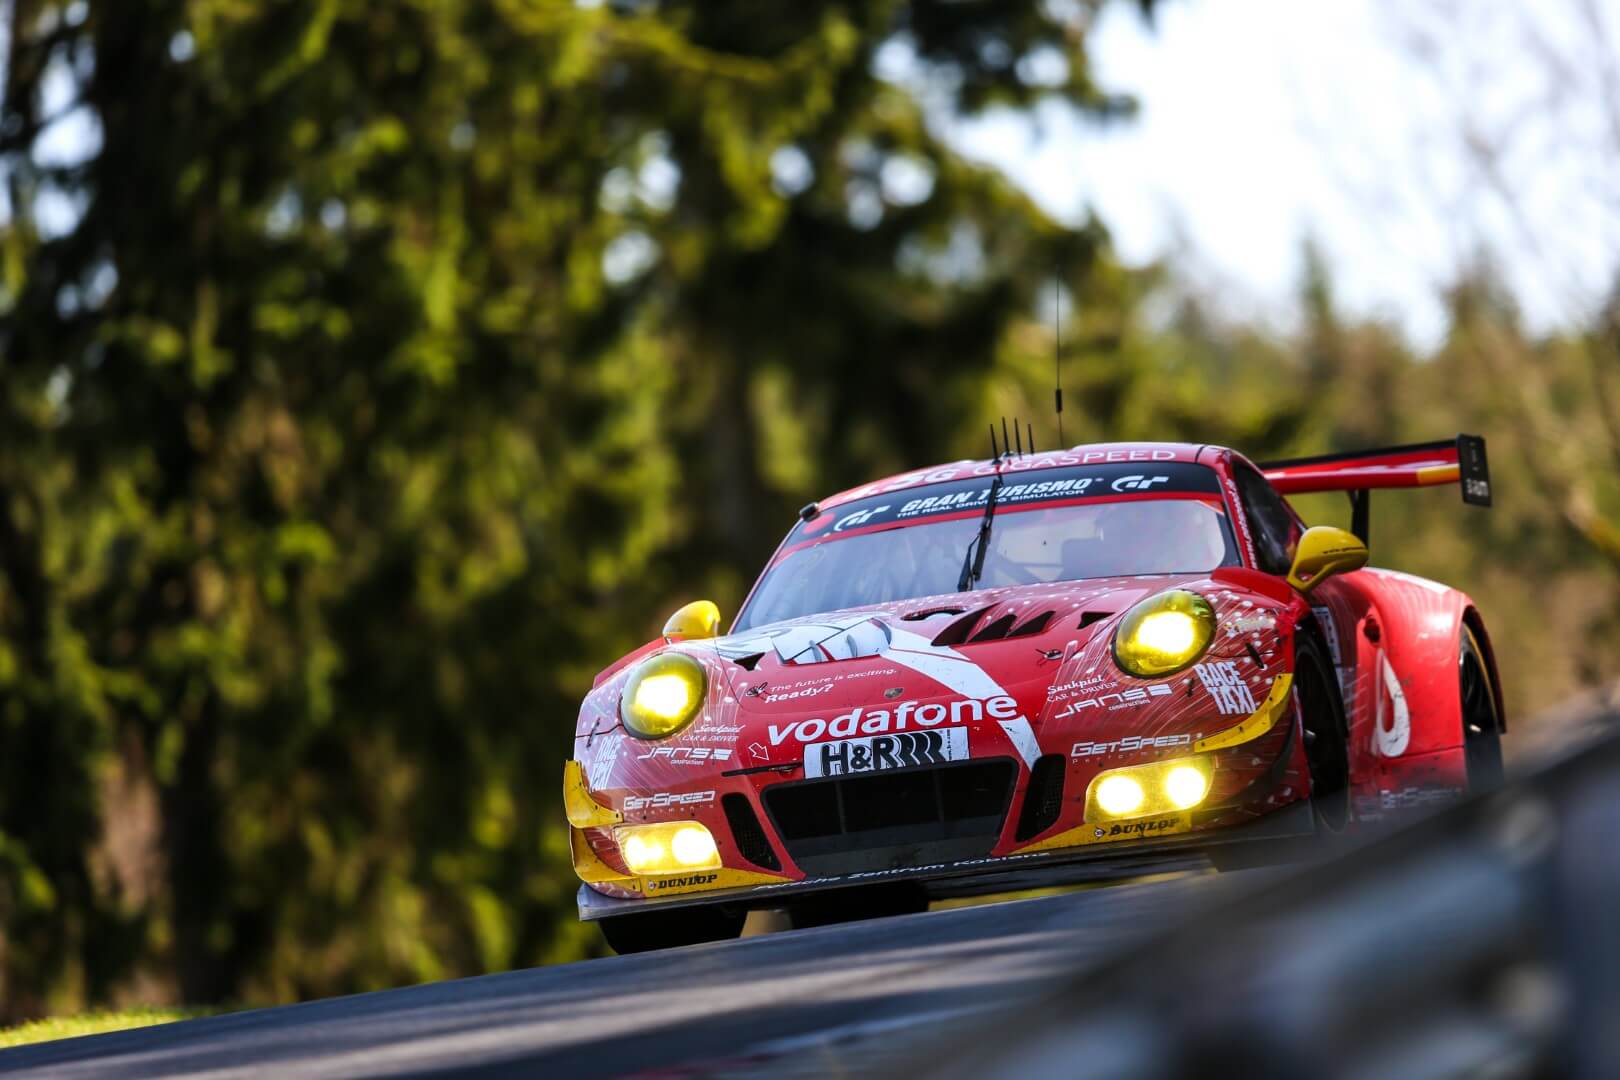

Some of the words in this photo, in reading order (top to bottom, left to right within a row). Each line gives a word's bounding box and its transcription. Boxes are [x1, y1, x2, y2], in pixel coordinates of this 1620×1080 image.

[973, 449, 1176, 475] GIGASPEED
[897, 508, 919, 518] THE
[922, 504, 953, 514] REAL
[1010, 488, 1085, 502] SIMULATOR
[900, 491, 974, 513] GRAN
[978, 478, 1093, 502] TURISMO
[765, 683, 834, 704] Ready?
[770, 684, 792, 692] The
[795, 677, 832, 687] future
[1047, 693, 1068, 702] CAR
[1080, 681, 1119, 695] DRIVER
[767, 695, 1018, 746] vodafone
[1109, 818, 1180, 836] DUNLOP
[658, 874, 718, 888] DUNLOP
